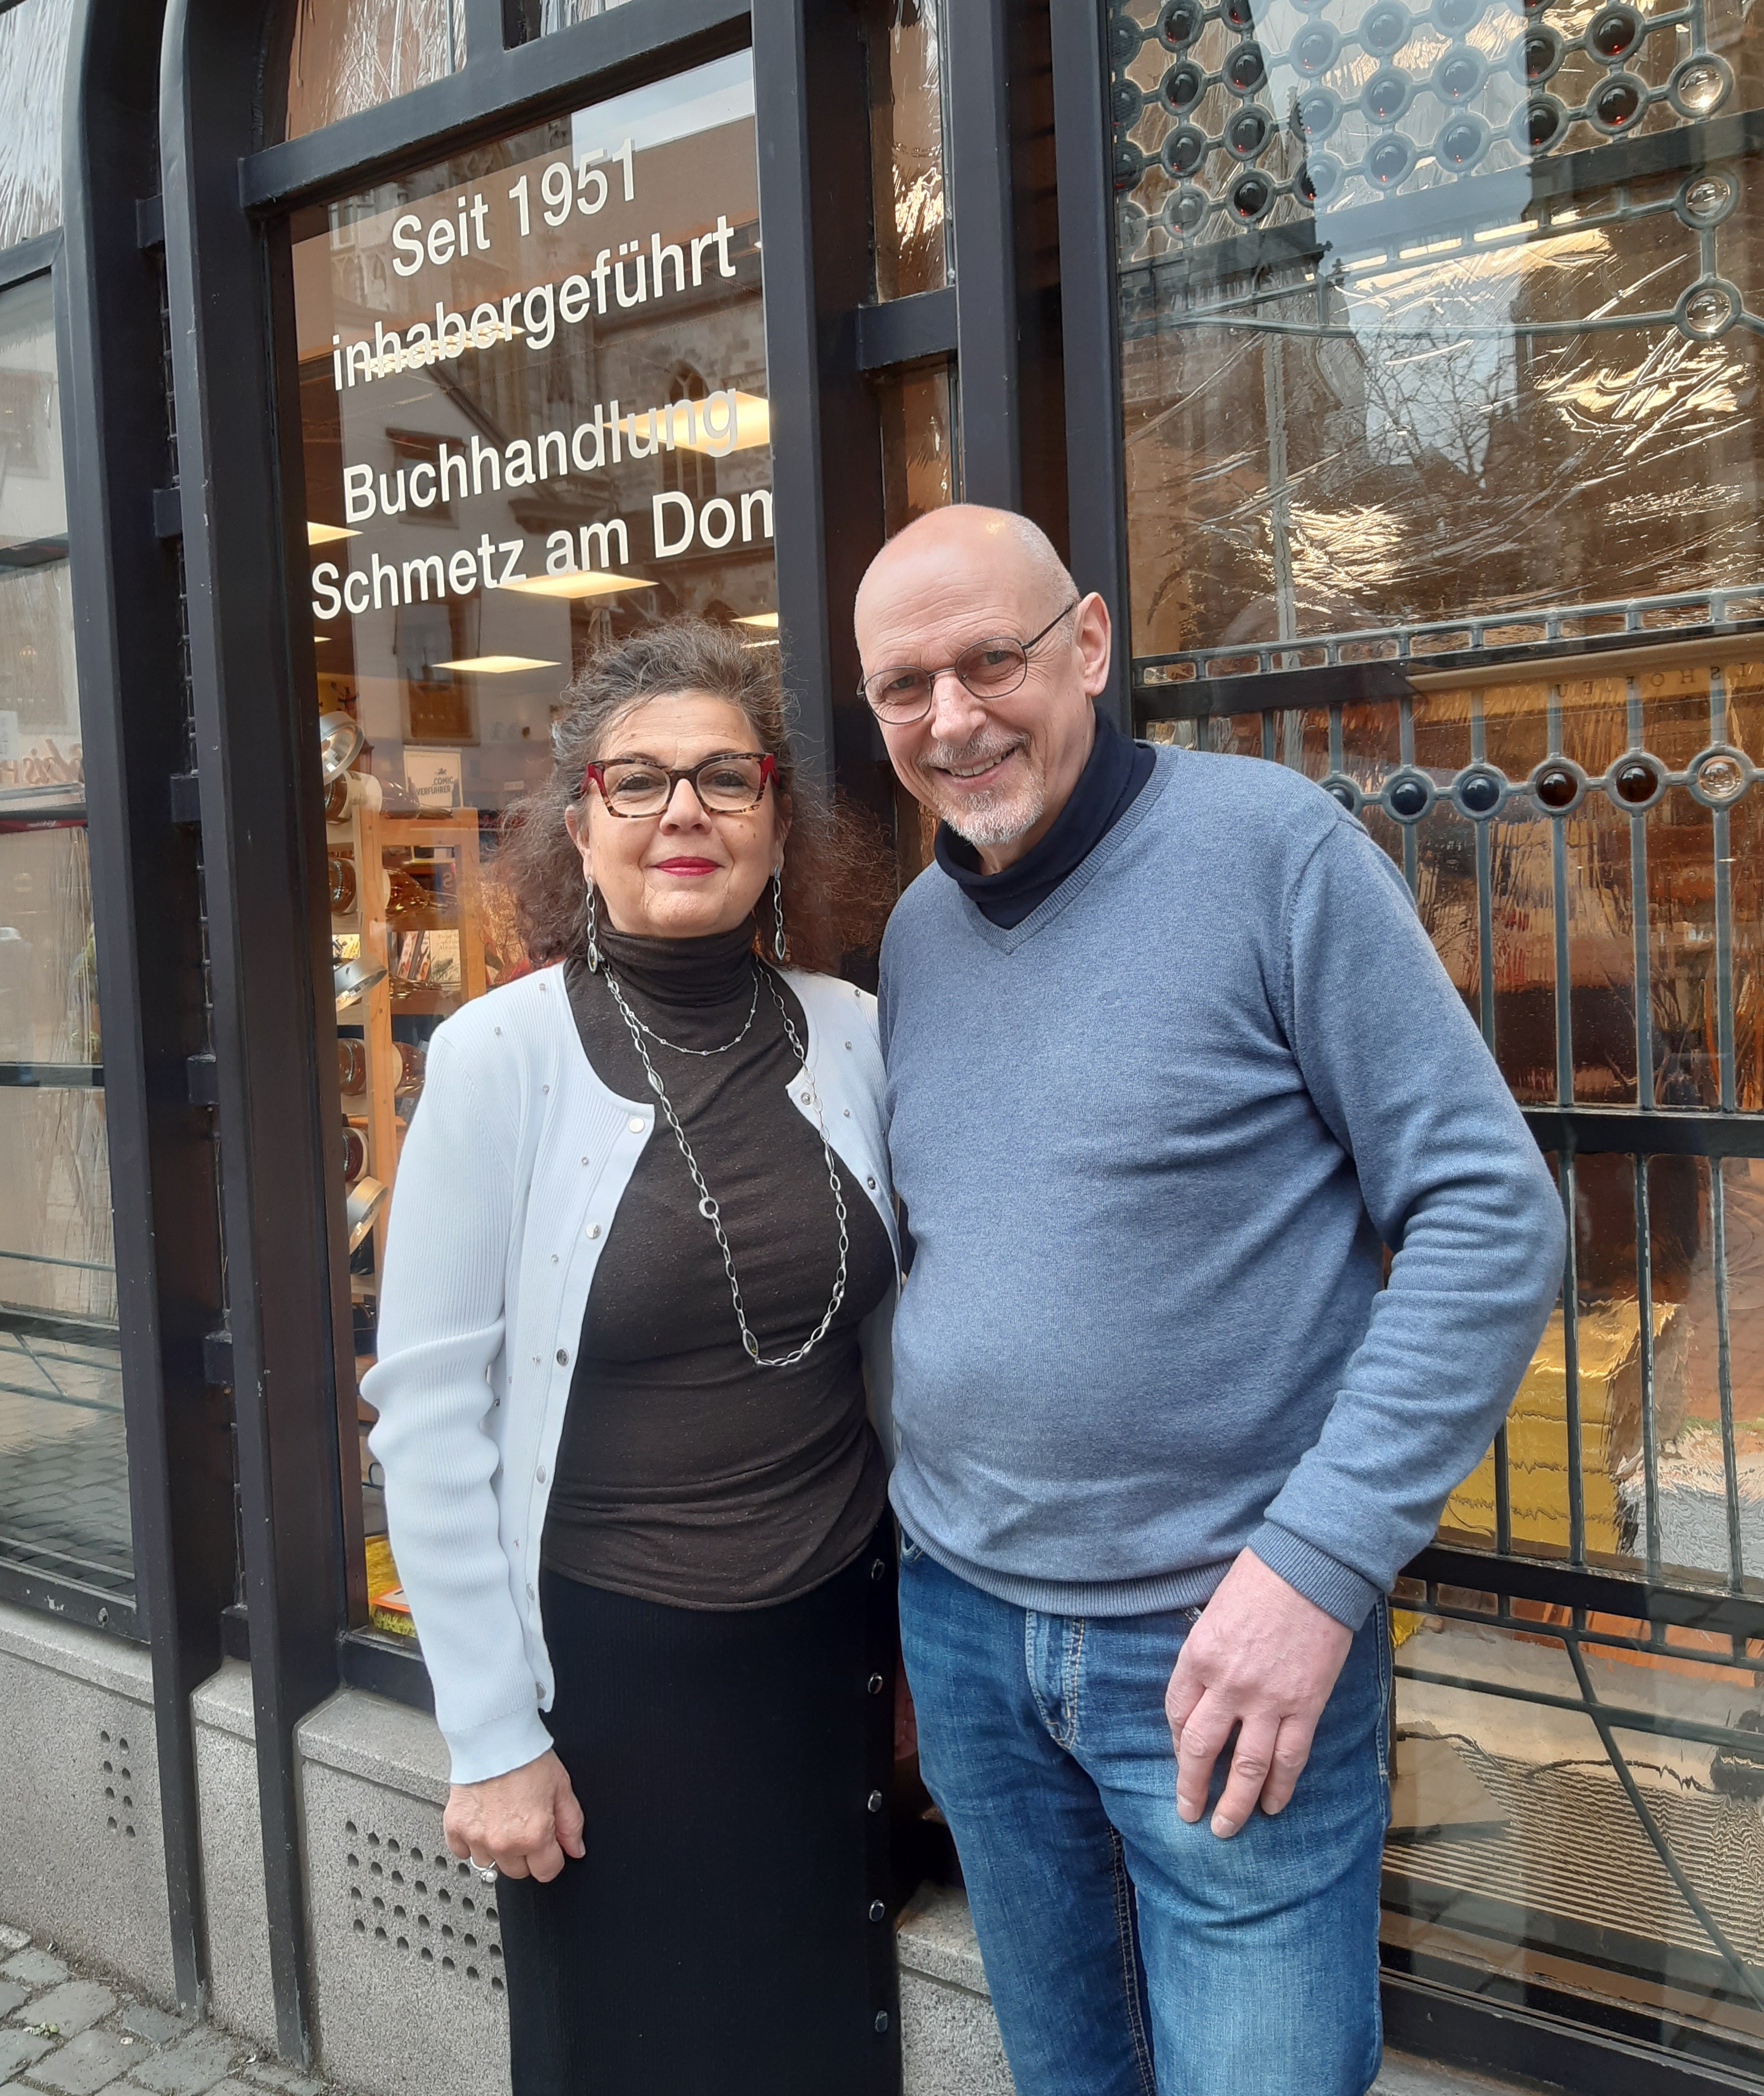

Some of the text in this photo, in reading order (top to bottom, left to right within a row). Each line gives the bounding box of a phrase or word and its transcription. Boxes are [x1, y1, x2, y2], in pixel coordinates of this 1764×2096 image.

[393, 138, 636, 276] Seit 1951
[333, 216, 736, 390] inhabergeführt
[343, 388, 737, 523] Buchhandlung
[311, 533, 527, 619] Schmetz
[546, 518, 628, 577] am
[433, 777, 453, 785] COMIC
